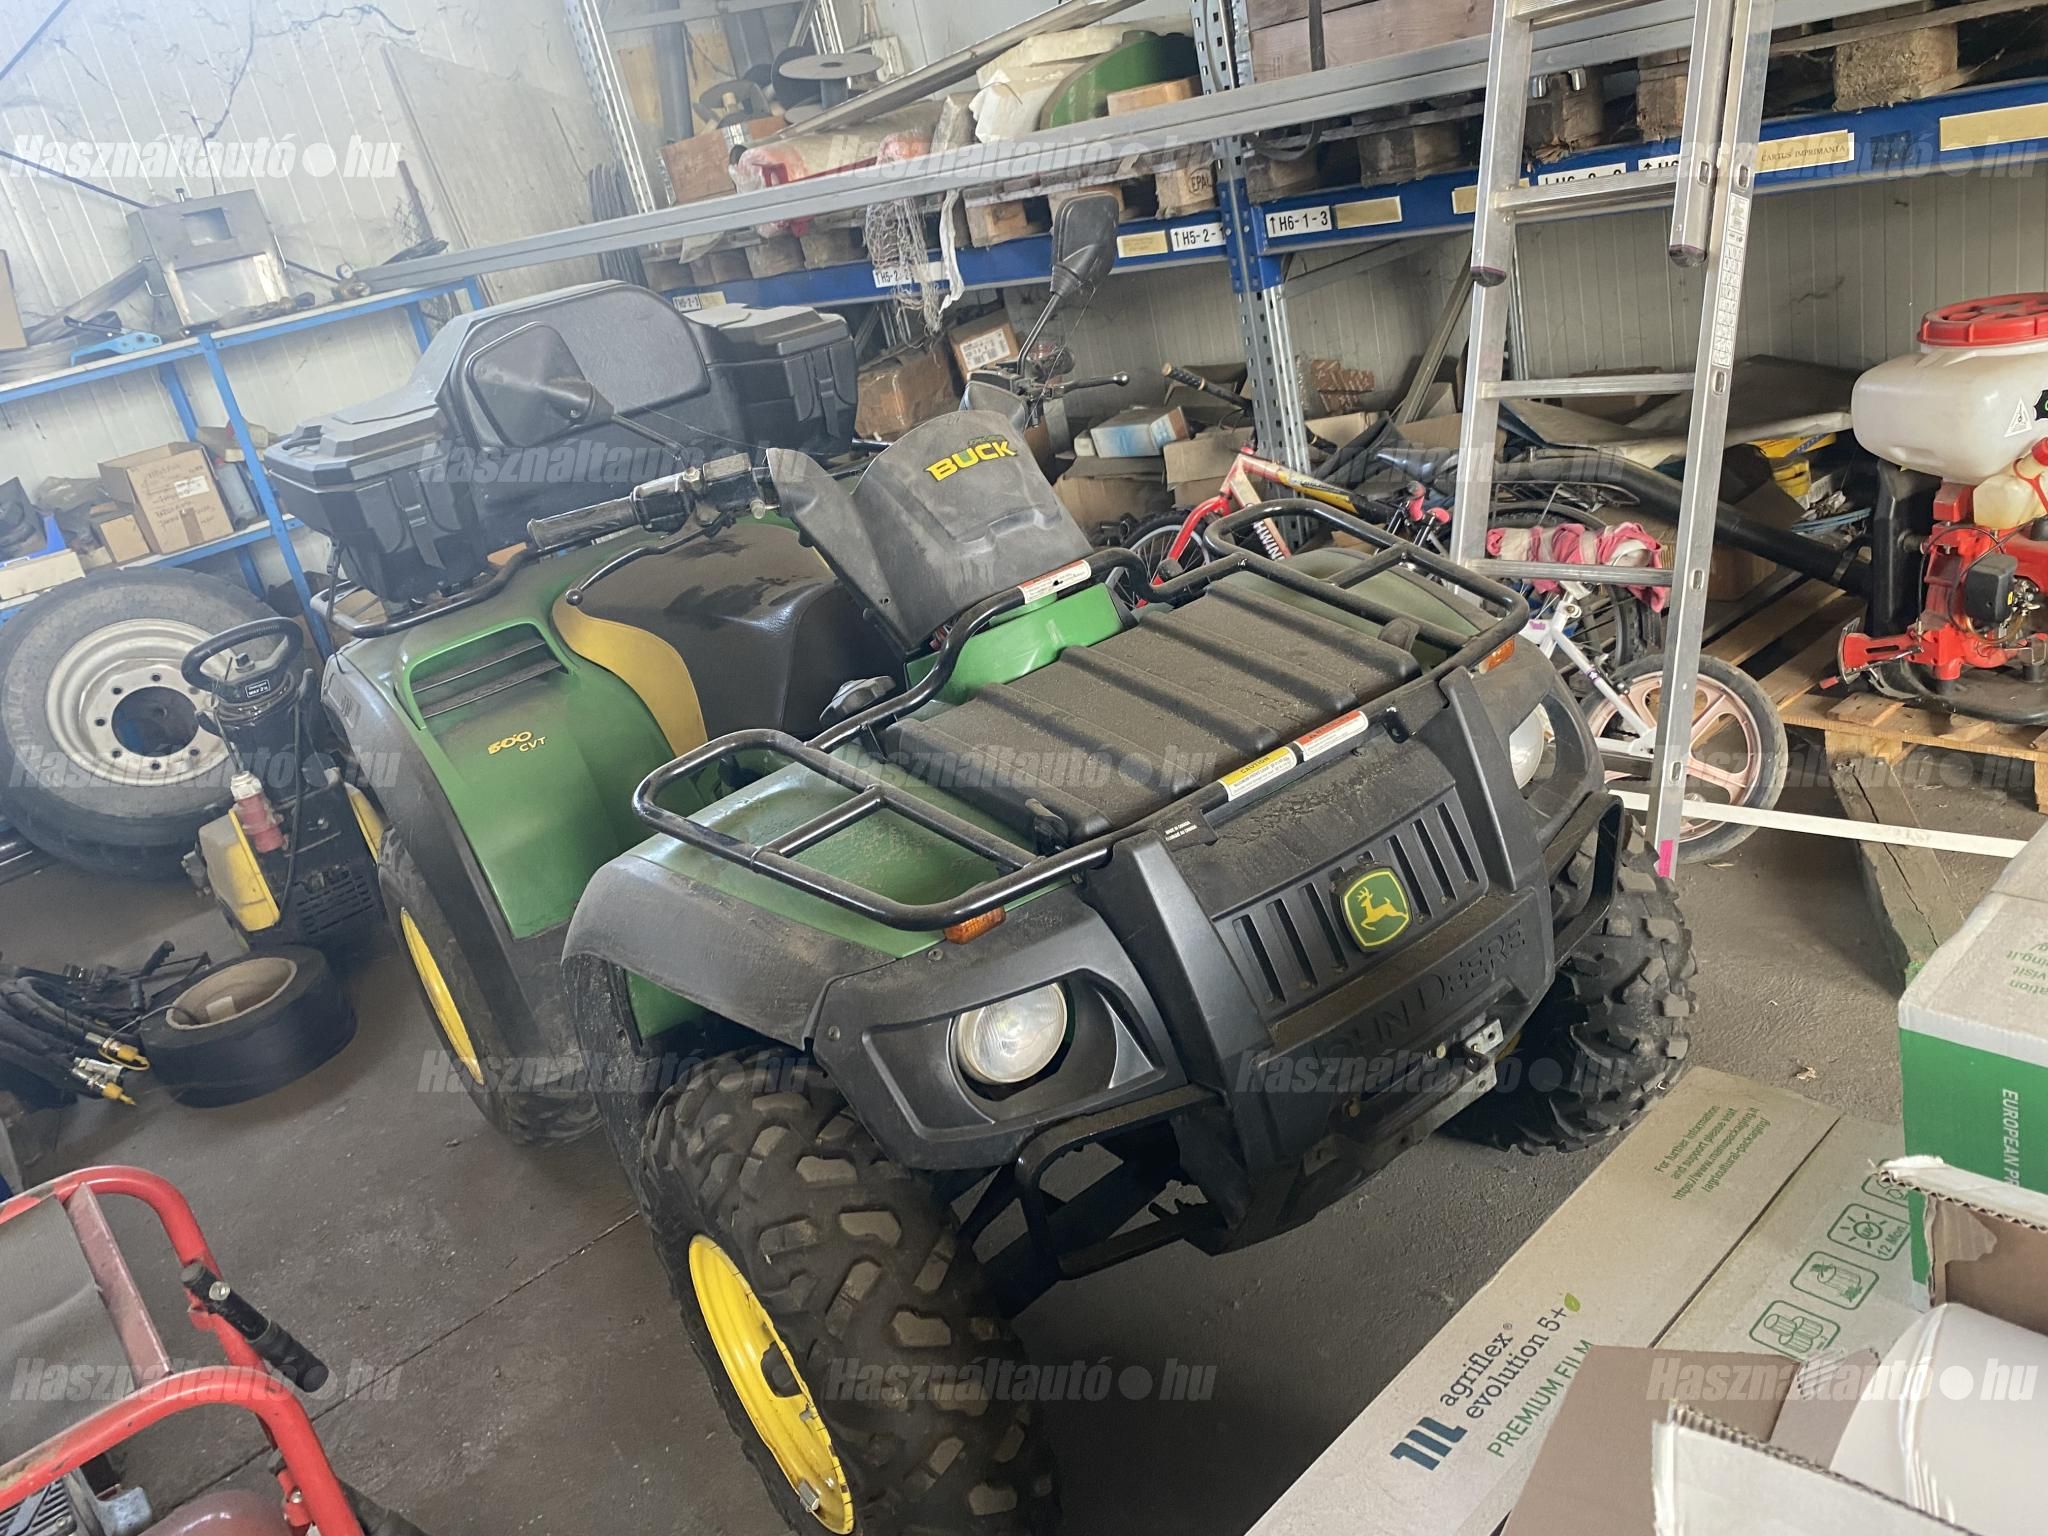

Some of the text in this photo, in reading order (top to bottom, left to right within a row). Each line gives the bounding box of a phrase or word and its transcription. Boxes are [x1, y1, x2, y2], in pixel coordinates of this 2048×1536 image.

[1278, 210, 1329, 232] H6-1-3
[924, 440, 1018, 482] BUCK
[1252, 519, 1286, 561] HWIN
[519, 736, 546, 752] CVT
[1654, 1105, 1721, 1173] For further information
[2002, 1088, 2020, 1188] EUROPEAN PR
[1671, 1165, 1687, 1180] and
[1682, 1141, 1709, 1168] support
[1877, 1244, 1893, 1257] 12
[1466, 1306, 1568, 1419] evolution 5+
[1486, 1378, 1564, 1458] PREMIUM
